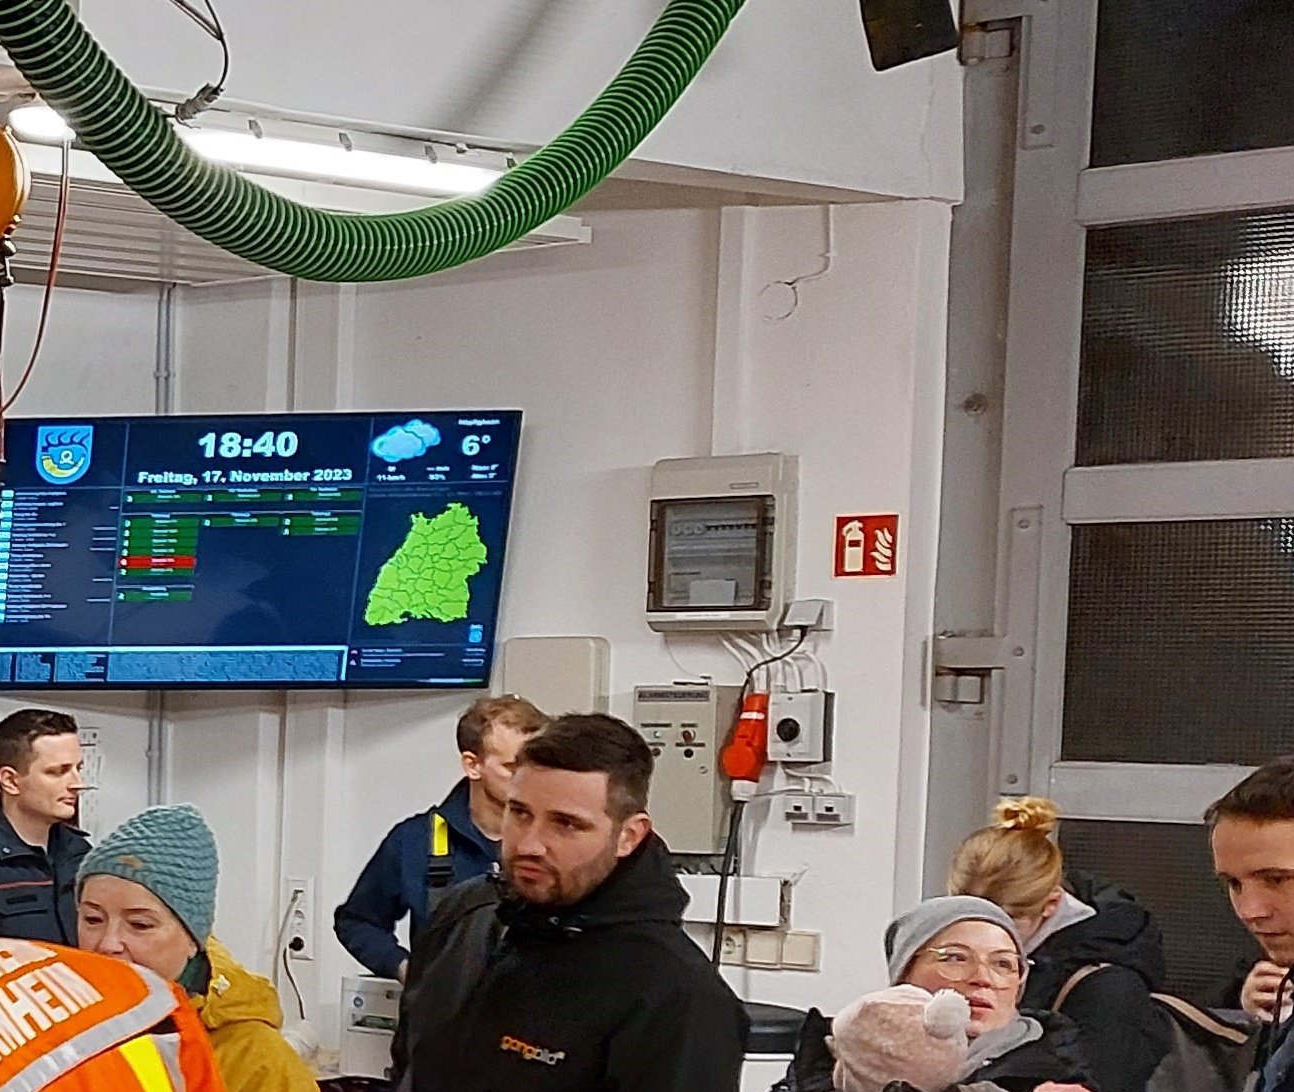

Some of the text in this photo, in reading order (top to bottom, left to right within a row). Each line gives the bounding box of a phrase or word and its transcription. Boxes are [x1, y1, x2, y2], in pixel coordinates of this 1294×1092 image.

[198, 431, 298, 458] 18:40
[461, 434, 491, 456] 6°
[137, 468, 353, 485] Freitag, 17. November 2023
